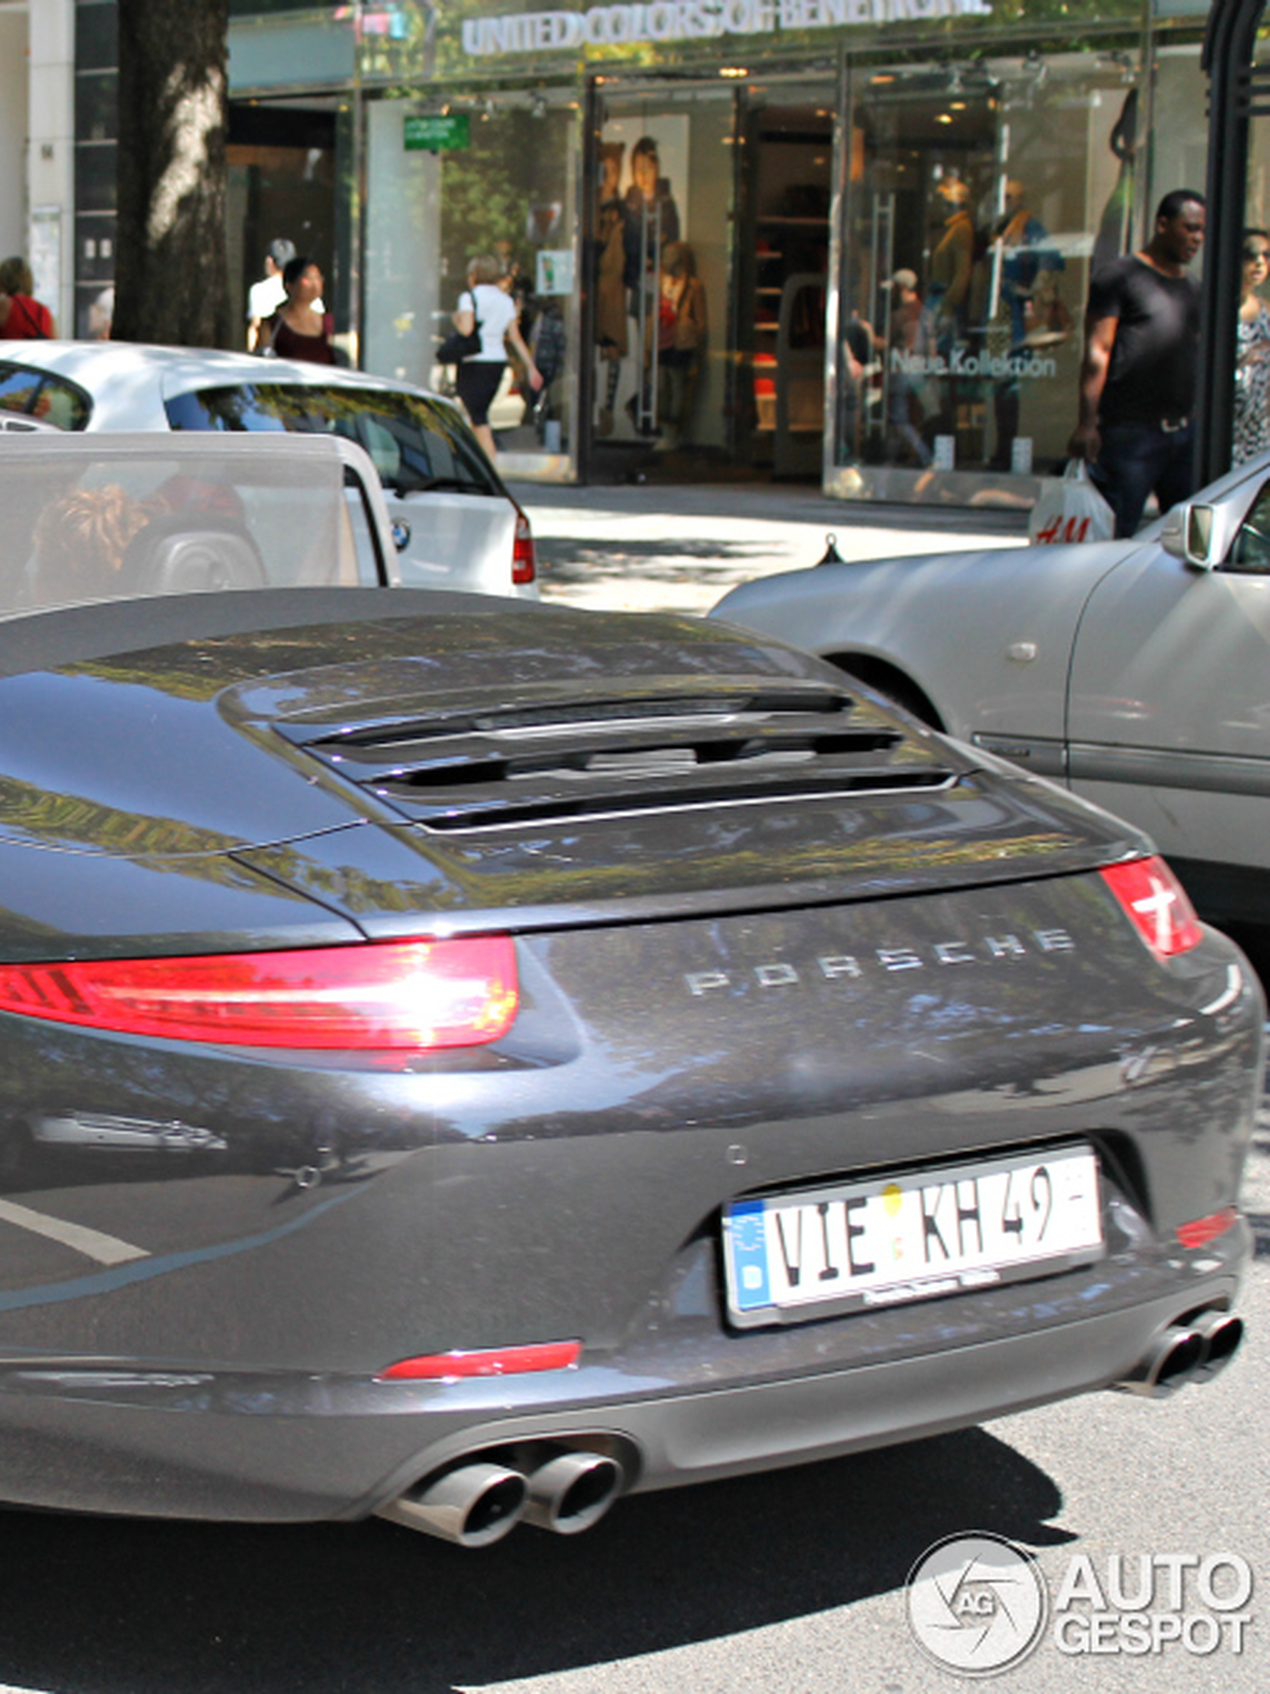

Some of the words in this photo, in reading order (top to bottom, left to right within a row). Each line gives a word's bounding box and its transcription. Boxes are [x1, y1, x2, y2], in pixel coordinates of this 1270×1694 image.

[462, 11, 583, 55] UNITED
[584, 0, 724, 44] COLORS
[890, 347, 947, 375] Neue
[949, 349, 1057, 378] Kollektion
[685, 928, 1074, 996] PORSCHE
[775, 1197, 876, 1288] VIE
[919, 1177, 984, 1263] KH
[1002, 1165, 1054, 1245] 49
